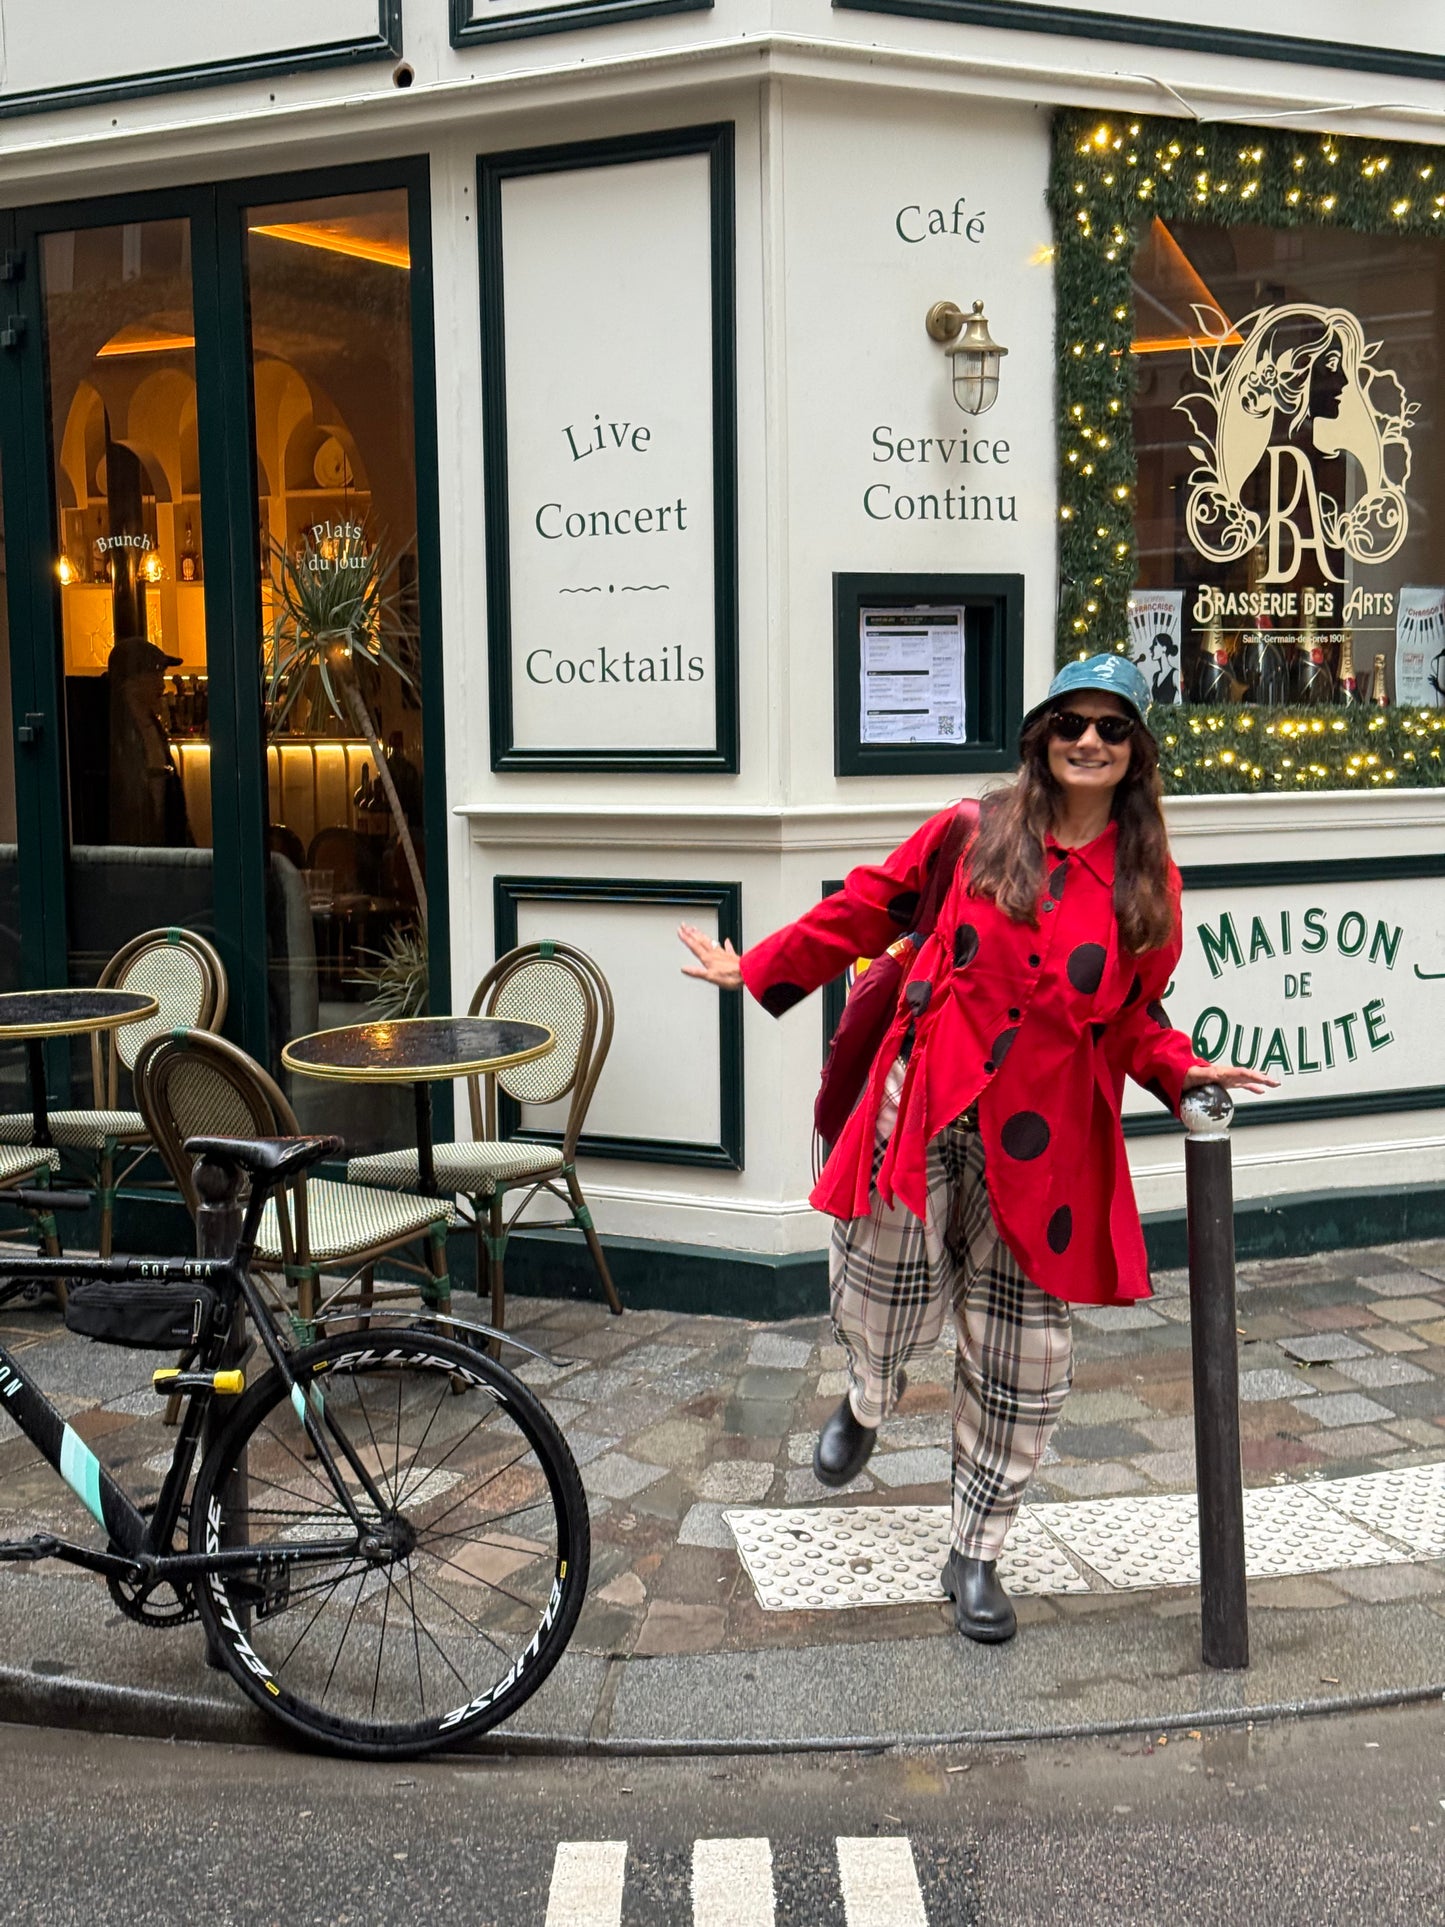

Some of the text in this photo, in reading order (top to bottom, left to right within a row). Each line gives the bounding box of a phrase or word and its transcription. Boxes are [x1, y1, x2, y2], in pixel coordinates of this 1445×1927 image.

[896, 197, 987, 244] Café
[561, 414, 651, 462] Live
[872, 425, 1010, 464] Service
[535, 498, 688, 540] Concert
[863, 484, 1019, 522] Continu
[95, 533, 151, 553] Brunch
[311, 521, 363, 544] Plats
[308, 554, 367, 574] du jour
[1192, 584, 1394, 623] BRASSERIE DES ARTS
[1329, 634, 1345, 644] 1901
[526, 645, 705, 684] Cocktails
[1197, 907, 1403, 979] MAISON
[1284, 972, 1312, 1000] DE
